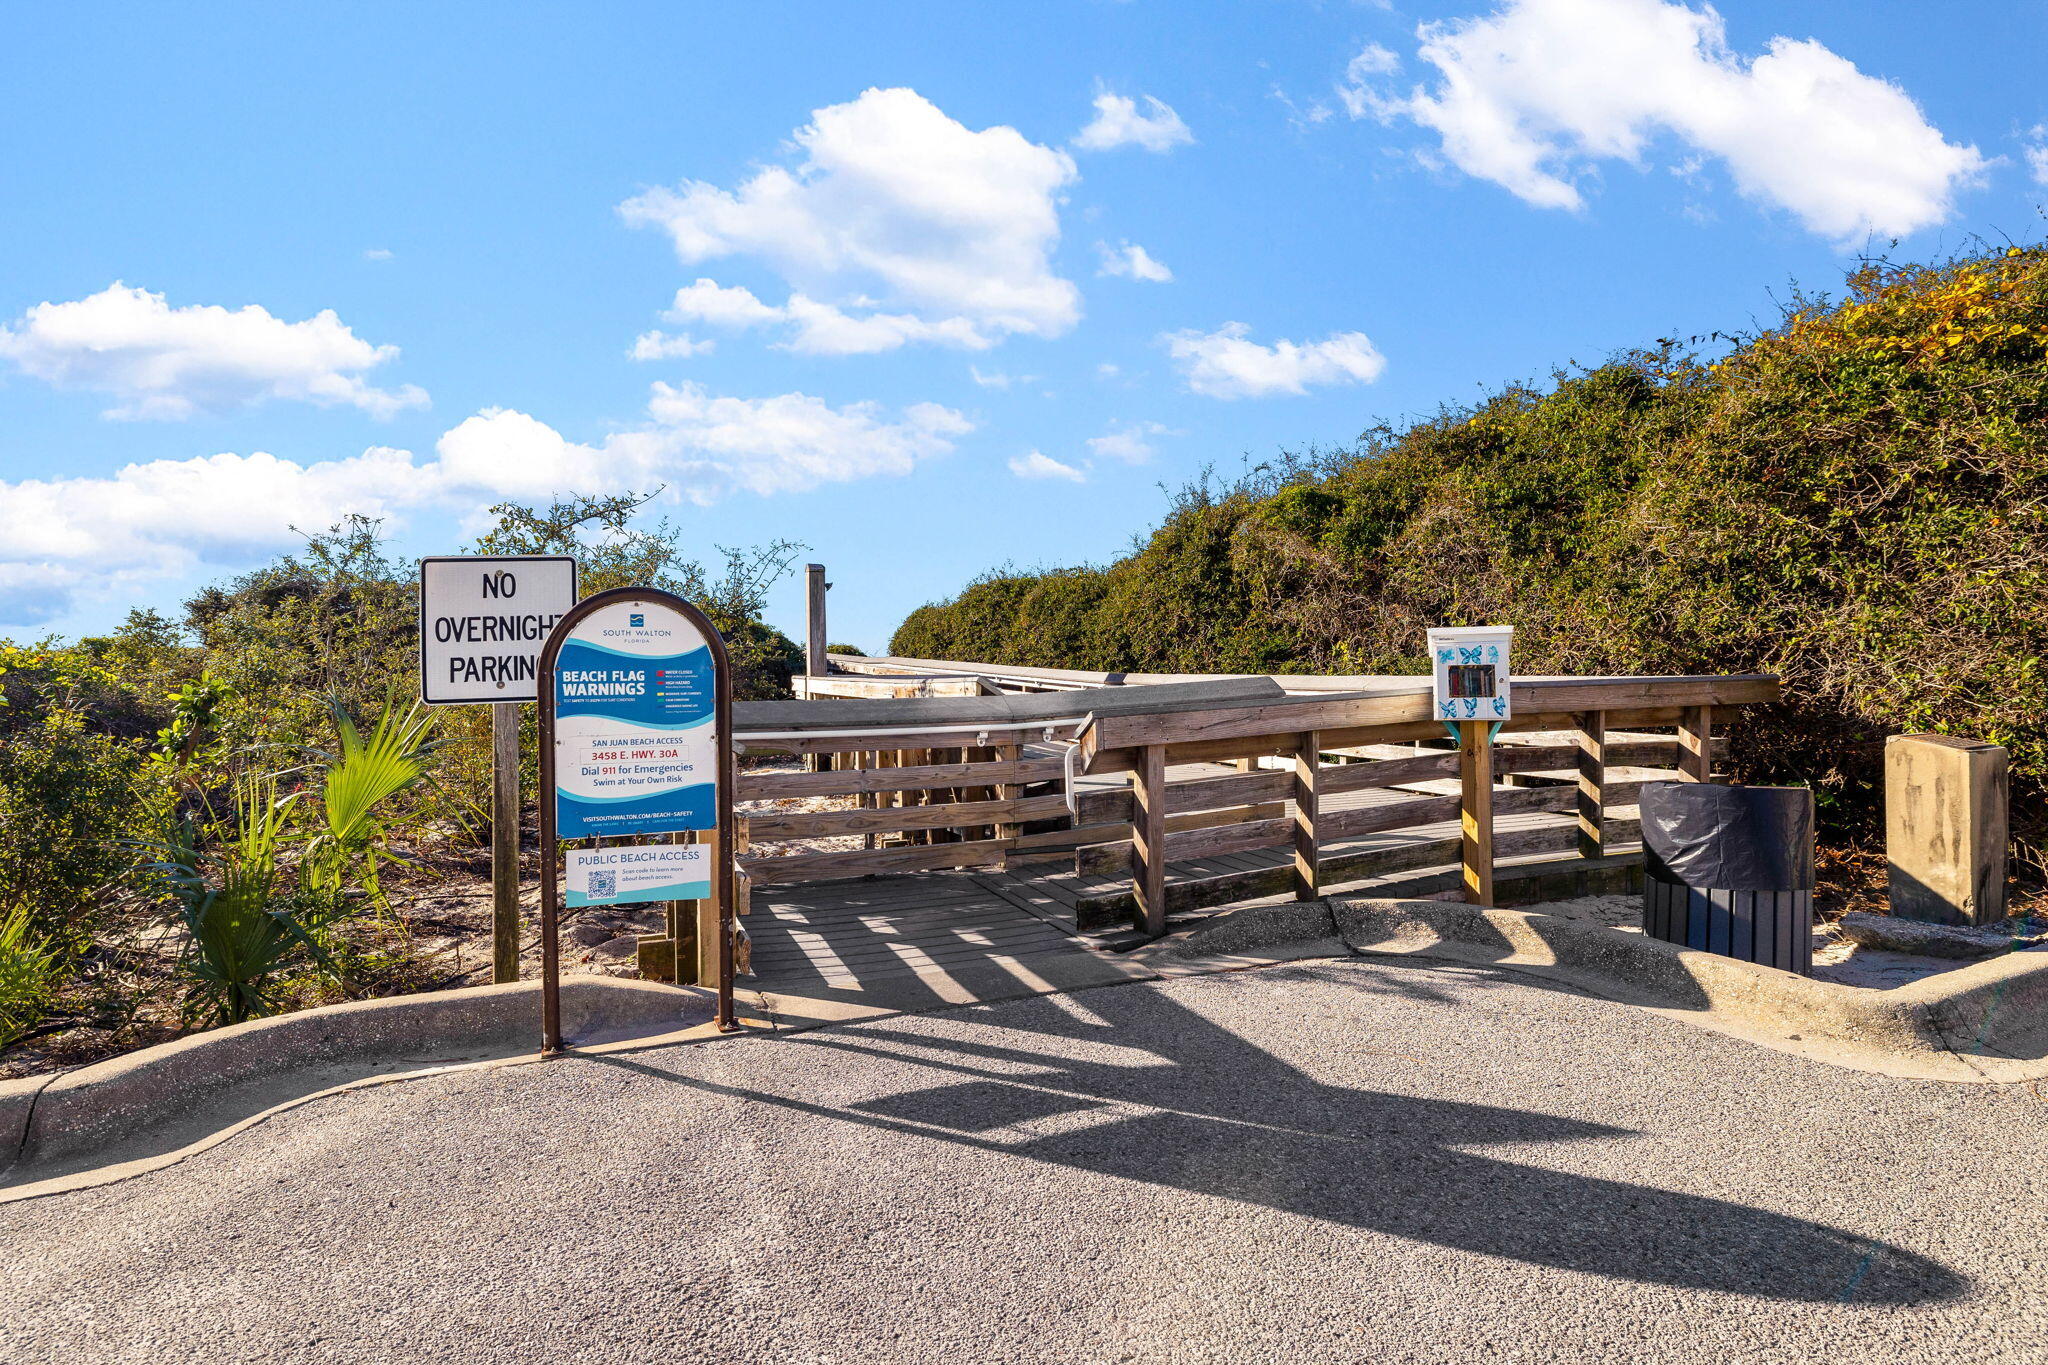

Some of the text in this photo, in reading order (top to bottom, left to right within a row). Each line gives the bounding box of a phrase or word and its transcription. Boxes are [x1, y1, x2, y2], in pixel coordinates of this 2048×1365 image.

[482, 572, 517, 599] NO
[602, 629, 632, 637] SOUTH
[449, 655, 541, 683] PARKIN
[562, 670, 645, 682] BEACH FLAG
[562, 683, 645, 696] WARNINGS
[592, 736, 683, 747] SAN JUAN BEACH ACCESS
[592, 749, 679, 761] 3458 E. HWY. 30A
[581, 762, 694, 776] Dial 911 for Emergencies
[593, 774, 683, 787] Swim at Your Own Risk
[582, 810, 693, 823] VISITSOUTHWALTON.COM/BEACH-SAFETY
[578, 851, 700, 866] PUBLIC BEACH ACCESS
